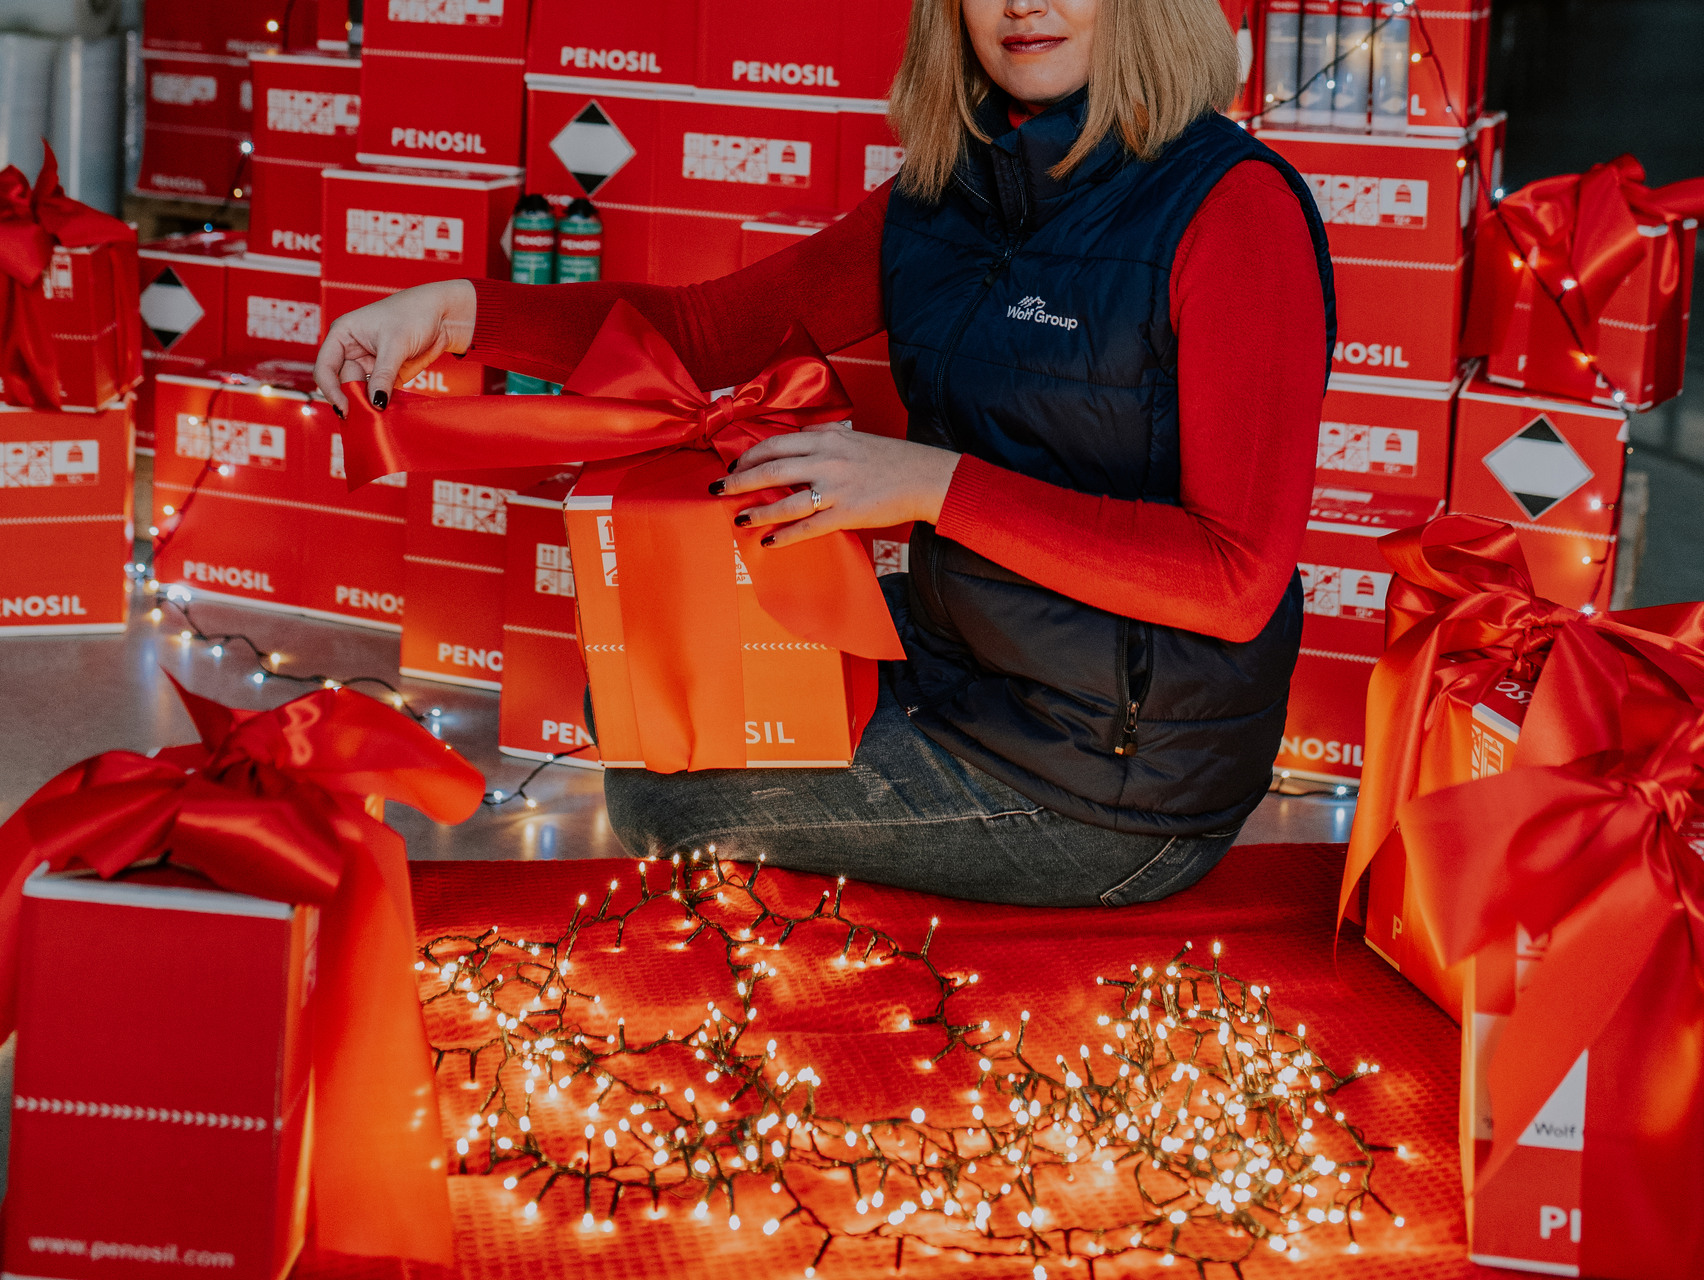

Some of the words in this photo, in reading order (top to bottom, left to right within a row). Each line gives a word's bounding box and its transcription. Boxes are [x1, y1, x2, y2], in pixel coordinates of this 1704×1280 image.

[560, 46, 662, 74] PENOSIL
[733, 60, 840, 87] PENOSIL
[391, 127, 486, 154] PENOSIL
[1007, 305, 1035, 321] Wolf
[1034, 309, 1078, 331] Group
[183, 560, 274, 593] PENOSIL
[0, 595, 88, 618] NOSIL
[744, 721, 796, 745] SIL
[1534, 1122, 1576, 1139] Wolf
[28, 1236, 235, 1269] www.penosil.com
